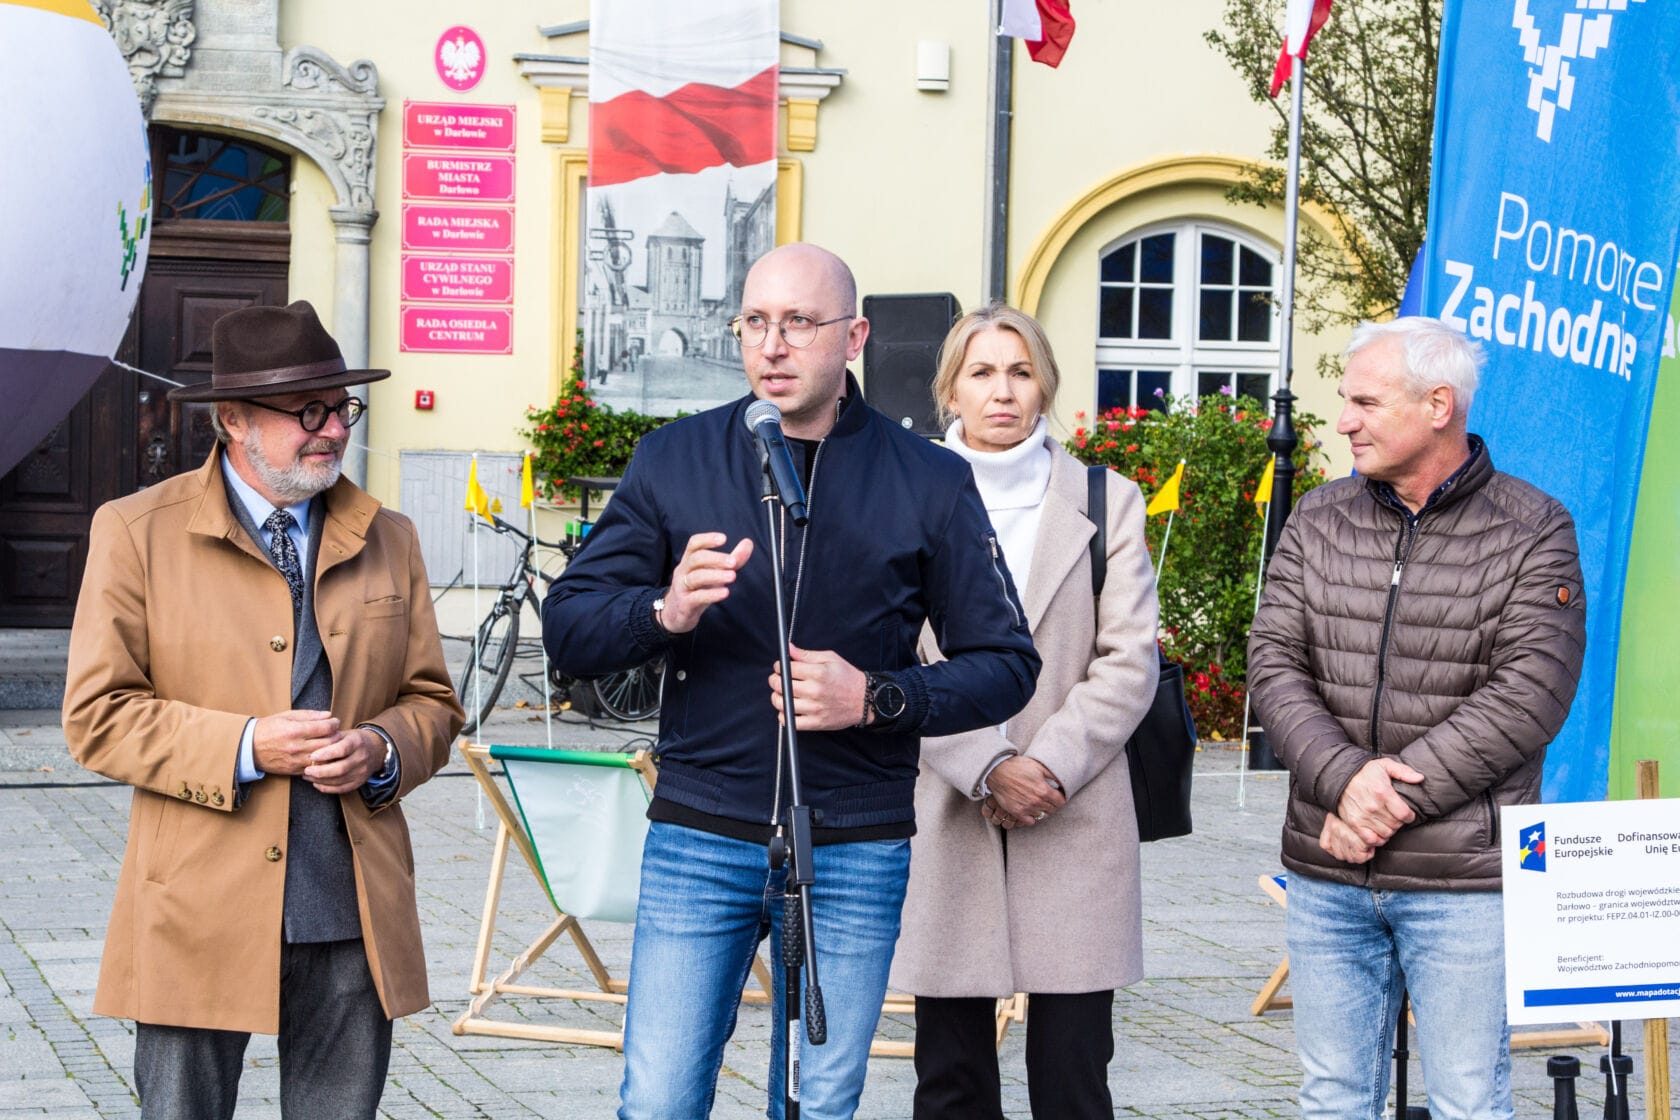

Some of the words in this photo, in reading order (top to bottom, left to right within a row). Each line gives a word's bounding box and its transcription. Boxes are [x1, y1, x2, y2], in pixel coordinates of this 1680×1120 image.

[417, 114, 456, 127] URZĄD
[458, 115, 503, 127] MIEJSKI
[433, 128, 442, 136] w
[444, 127, 487, 138] Darłowie
[427, 160, 492, 172] BURMISTRZ
[438, 172, 480, 183] MIASTA
[439, 184, 480, 195] Darłowo
[417, 216, 448, 227] RADA
[450, 217, 499, 229] MIEJSKA
[432, 230, 441, 238] w
[442, 229, 485, 240] Darłowie
[419, 261, 458, 273] URZĄD
[460, 263, 496, 273] STANU
[423, 273, 493, 285] CYWILNEGO
[431, 287, 440, 295] w
[441, 286, 484, 297] Darłowie
[416, 318, 447, 329] RADA
[449, 319, 497, 330] OSIEDLA
[428, 330, 485, 341] CENTRUM
[1554, 834, 1602, 845] Fundusze
[1554, 846, 1613, 859] Europejskie
[1645, 844, 1669, 856] Unię
[1556, 890, 1603, 899] Rozbudowa
[1605, 889, 1626, 899] drogi
[1557, 902, 1591, 912] Darłowo
[1598, 901, 1628, 911] granica
[1557, 915, 1566, 923] nr
[1568, 913, 1605, 924] projektu:
[1606, 910, 1680, 920] FEPZ.04.01-IZ.00-0
[1557, 954, 1604, 964] Beneficjent:
[1557, 964, 1613, 974] Województwo
[1615, 960, 1680, 970] Zachodniopomo
